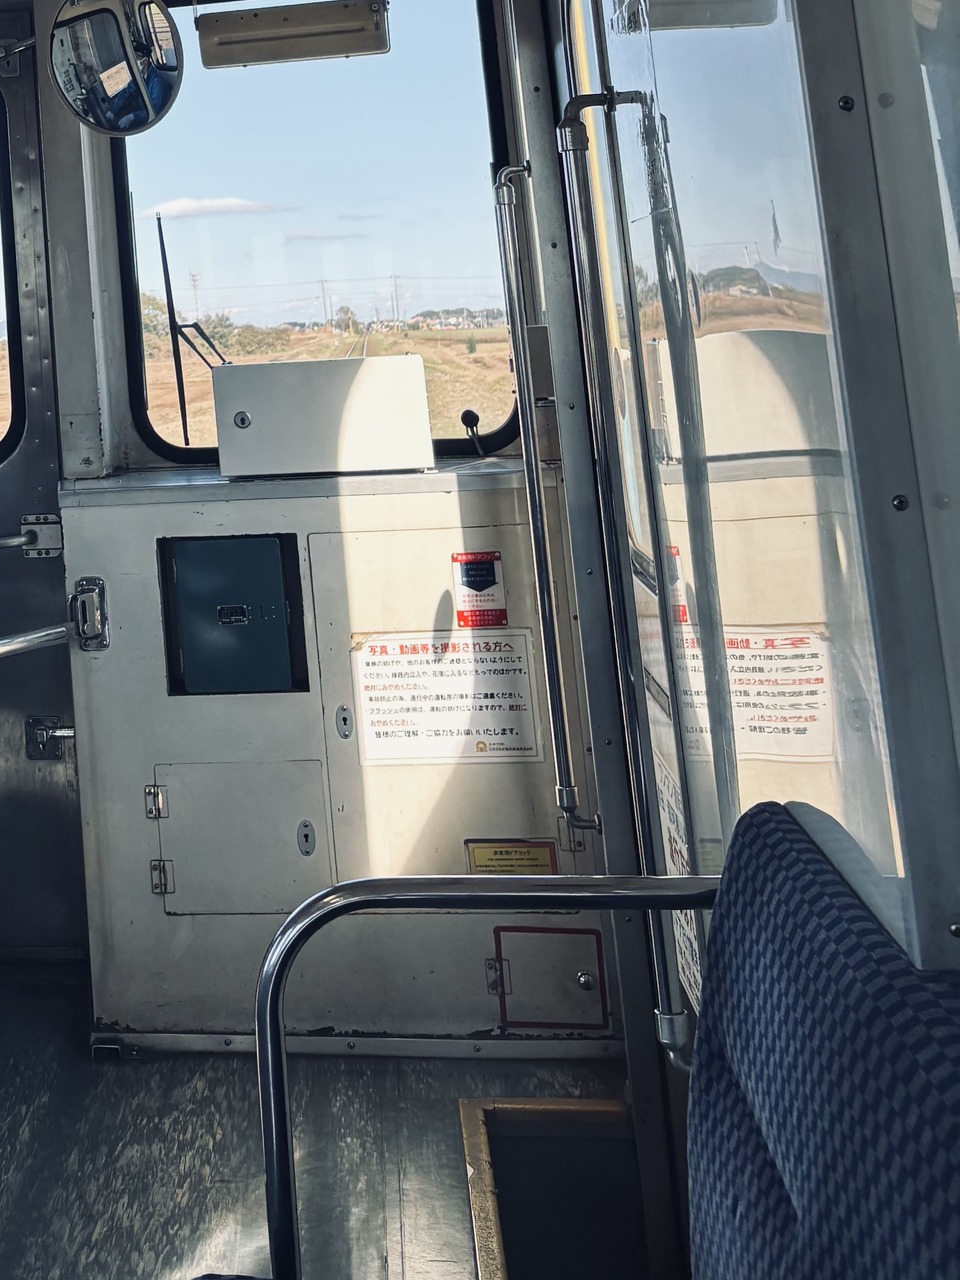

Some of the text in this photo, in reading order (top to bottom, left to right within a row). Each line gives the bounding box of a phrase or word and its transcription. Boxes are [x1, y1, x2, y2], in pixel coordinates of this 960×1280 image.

[369, 641, 514, 655] 写真・動画等を撮影される方へ
